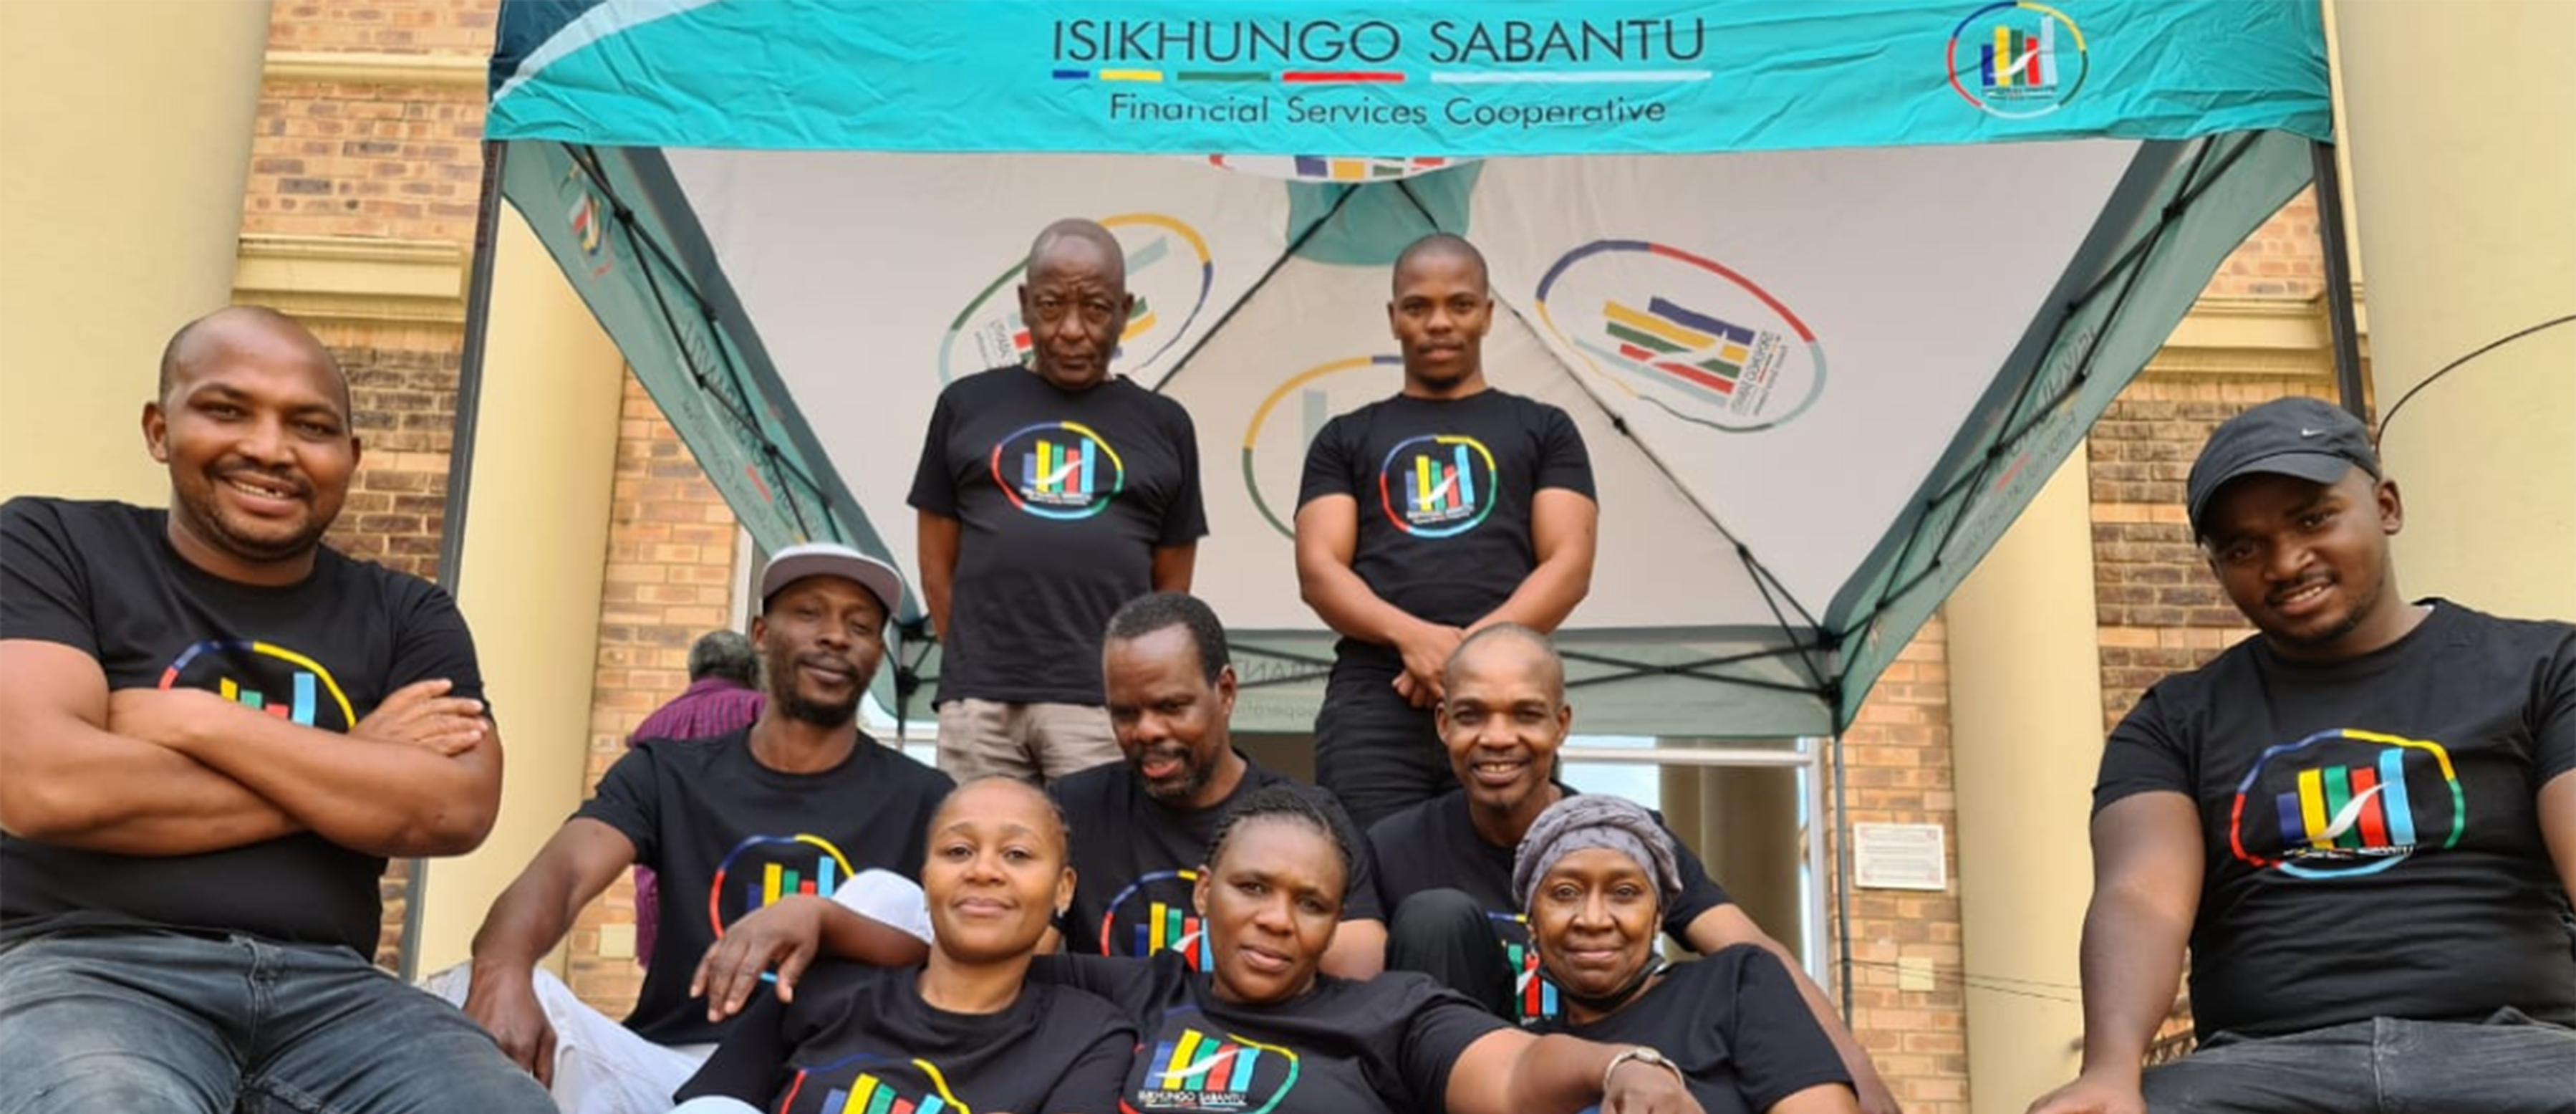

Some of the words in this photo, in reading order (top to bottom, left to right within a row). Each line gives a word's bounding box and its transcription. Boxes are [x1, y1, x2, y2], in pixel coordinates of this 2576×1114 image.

[1054, 20, 1401, 62] ISIKHUNGO
[1429, 18, 1705, 63] SABANTU
[1109, 94, 1269, 123] Financial
[1288, 96, 1427, 125] Services
[1444, 97, 1666, 130] Cooperative
